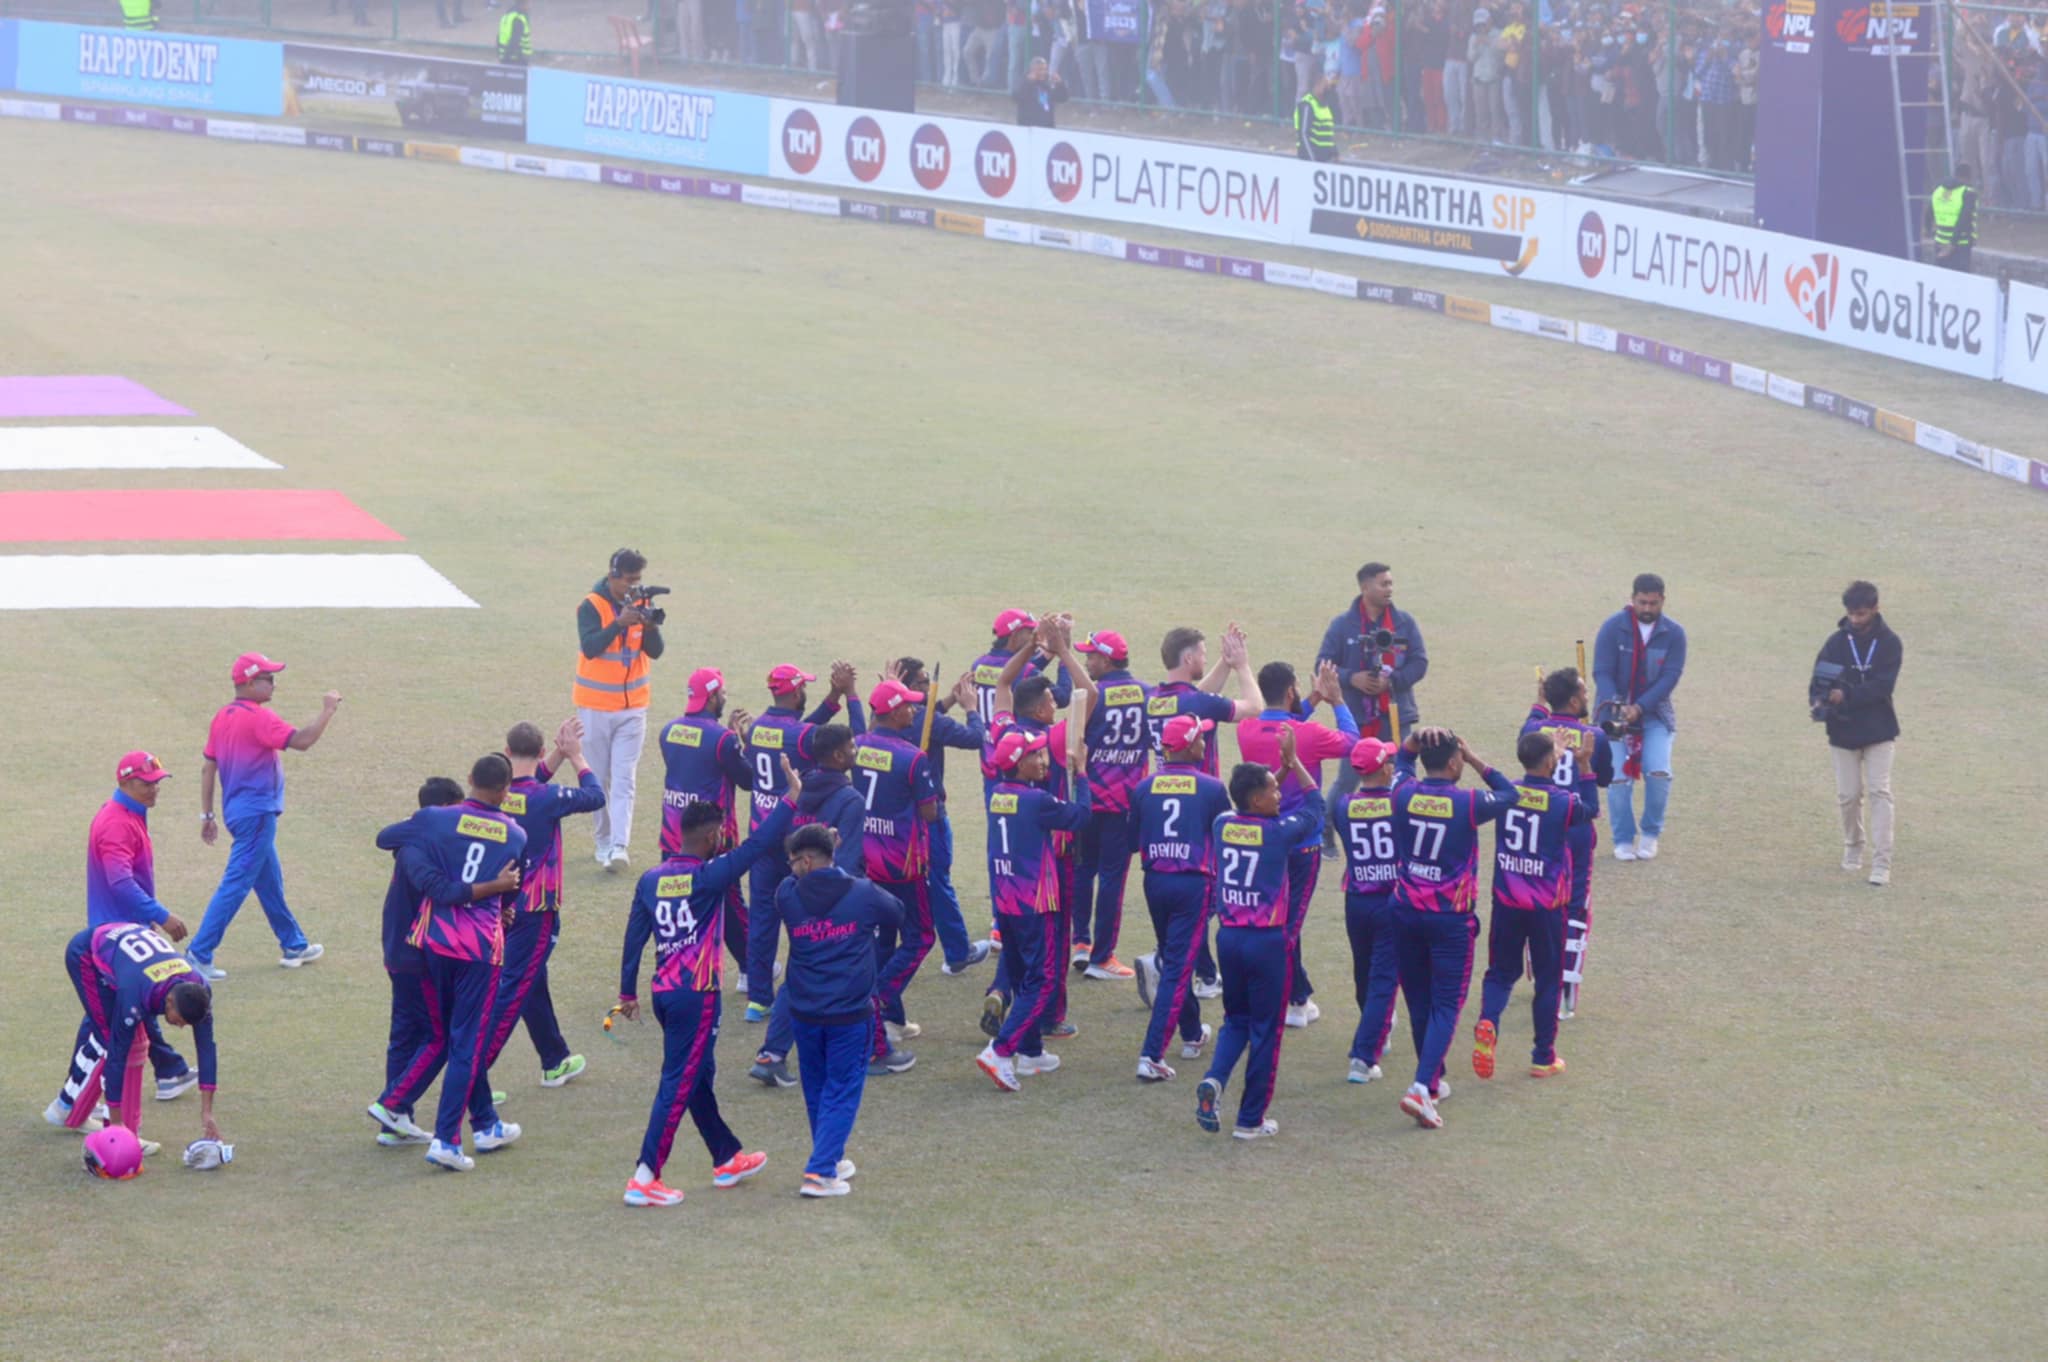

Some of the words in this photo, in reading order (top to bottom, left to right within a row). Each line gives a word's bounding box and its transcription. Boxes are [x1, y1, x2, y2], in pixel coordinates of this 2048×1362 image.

[1782, 14, 1815, 38] NPL
[1865, 17, 1919, 39] NPL
[79, 33, 218, 84] HAPPYDENT
[584, 82, 715, 140] HAPPYDENT
[787, 128, 816, 155] TCM
[851, 135, 880, 163] TCM
[915, 143, 945, 171] TCM
[979, 150, 1010, 178] TCM
[1050, 159, 1078, 185] TCM
[1091, 153, 1280, 225] PLATFORM
[1313, 170, 1485, 227] SIDDHARTHA
[1492, 194, 1536, 232] SIP
[1369, 219, 1430, 243] SIDDHARTHA
[1433, 230, 1473, 250] CAPITAL
[1581, 230, 1603, 258] TCM
[1613, 224, 1769, 306] PLATFORM
[1850, 268, 1982, 354] Soaltee
[1103, 706, 1143, 745] 33
[755, 752, 774, 790] 9
[862, 770, 878, 811] 7
[997, 816, 1010, 855] 1
[1162, 798, 1181, 838] 2
[1504, 808, 1540, 854] 51
[1350, 821, 1395, 860] 56
[1408, 818, 1447, 860] 77
[461, 842, 486, 884] 8
[1222, 848, 1259, 887] 27
[1497, 852, 1544, 877] SHUBH
[1222, 887, 1261, 907] LALIT
[655, 899, 698, 938] 94
